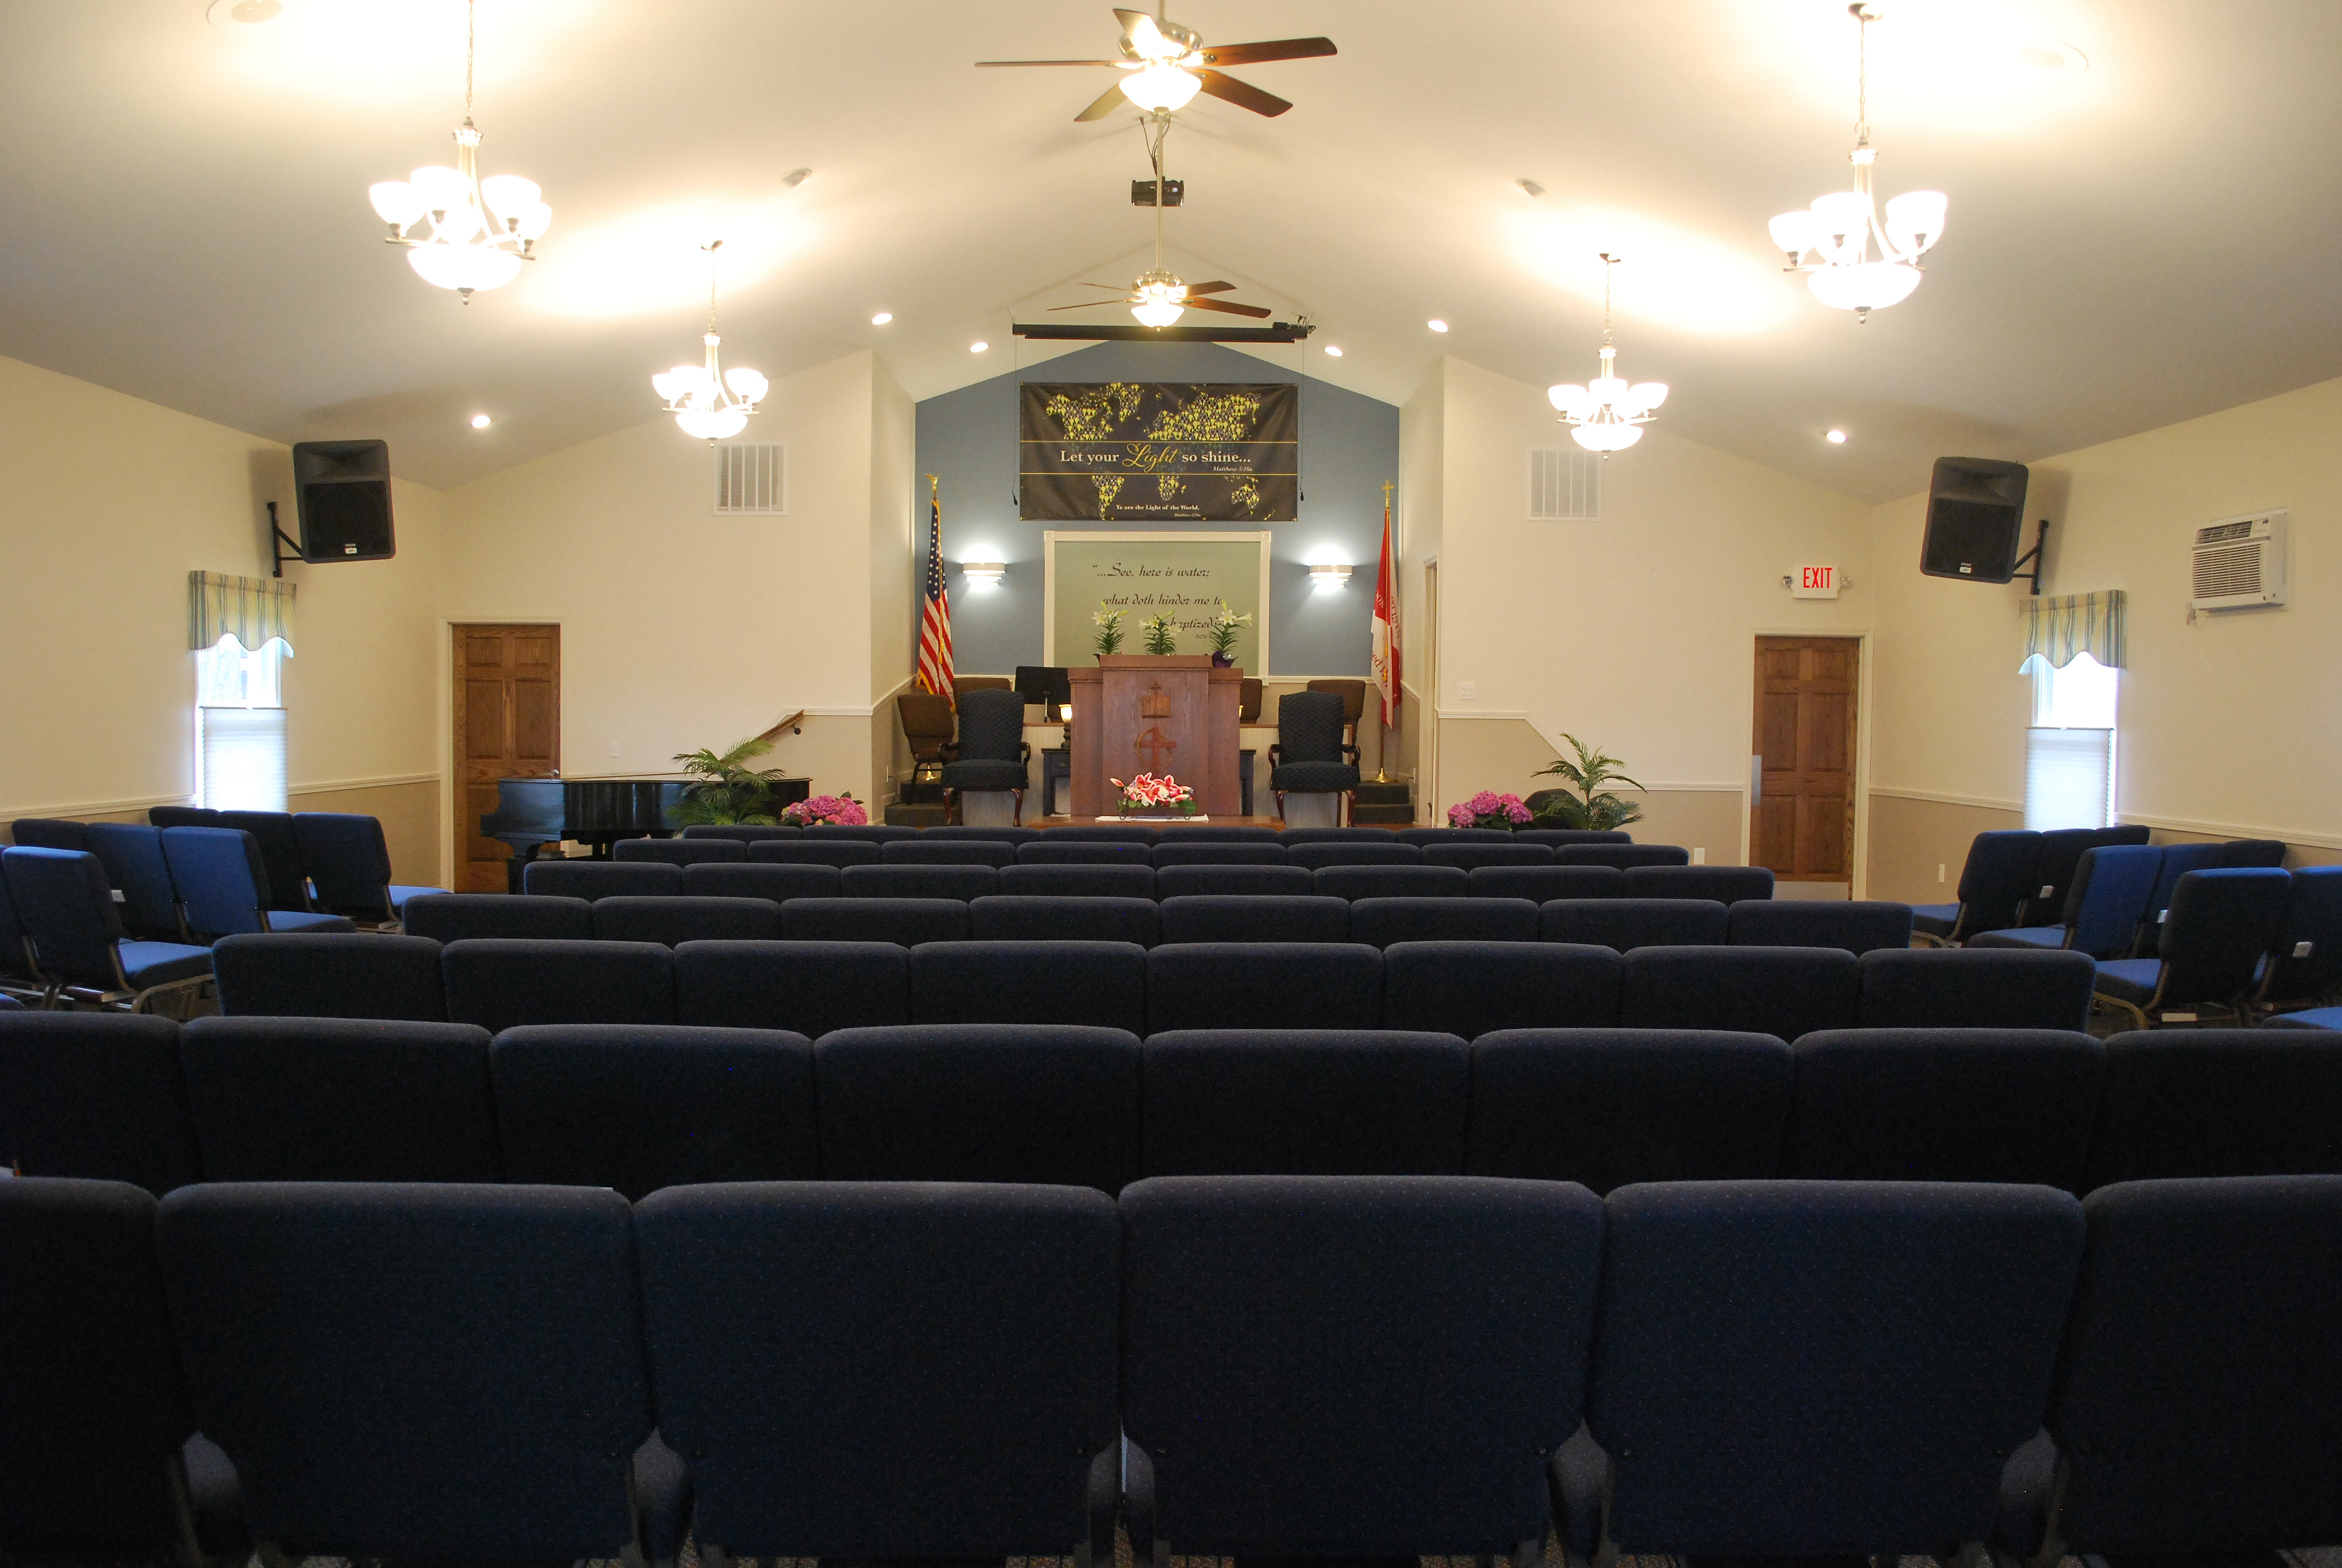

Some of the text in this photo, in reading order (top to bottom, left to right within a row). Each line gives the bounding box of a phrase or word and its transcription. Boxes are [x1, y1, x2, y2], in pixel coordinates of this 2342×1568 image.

[1060, 443, 1251, 473] Let your Light so shine...
[1139, 565, 1161, 576] here
[1165, 567, 1173, 576] is
[1177, 568, 1210, 578] water;
[1803, 567, 1833, 589] EXIT
[1103, 593, 1130, 605] what
[1132, 593, 1155, 605] doth
[1158, 593, 1191, 605] hinder
